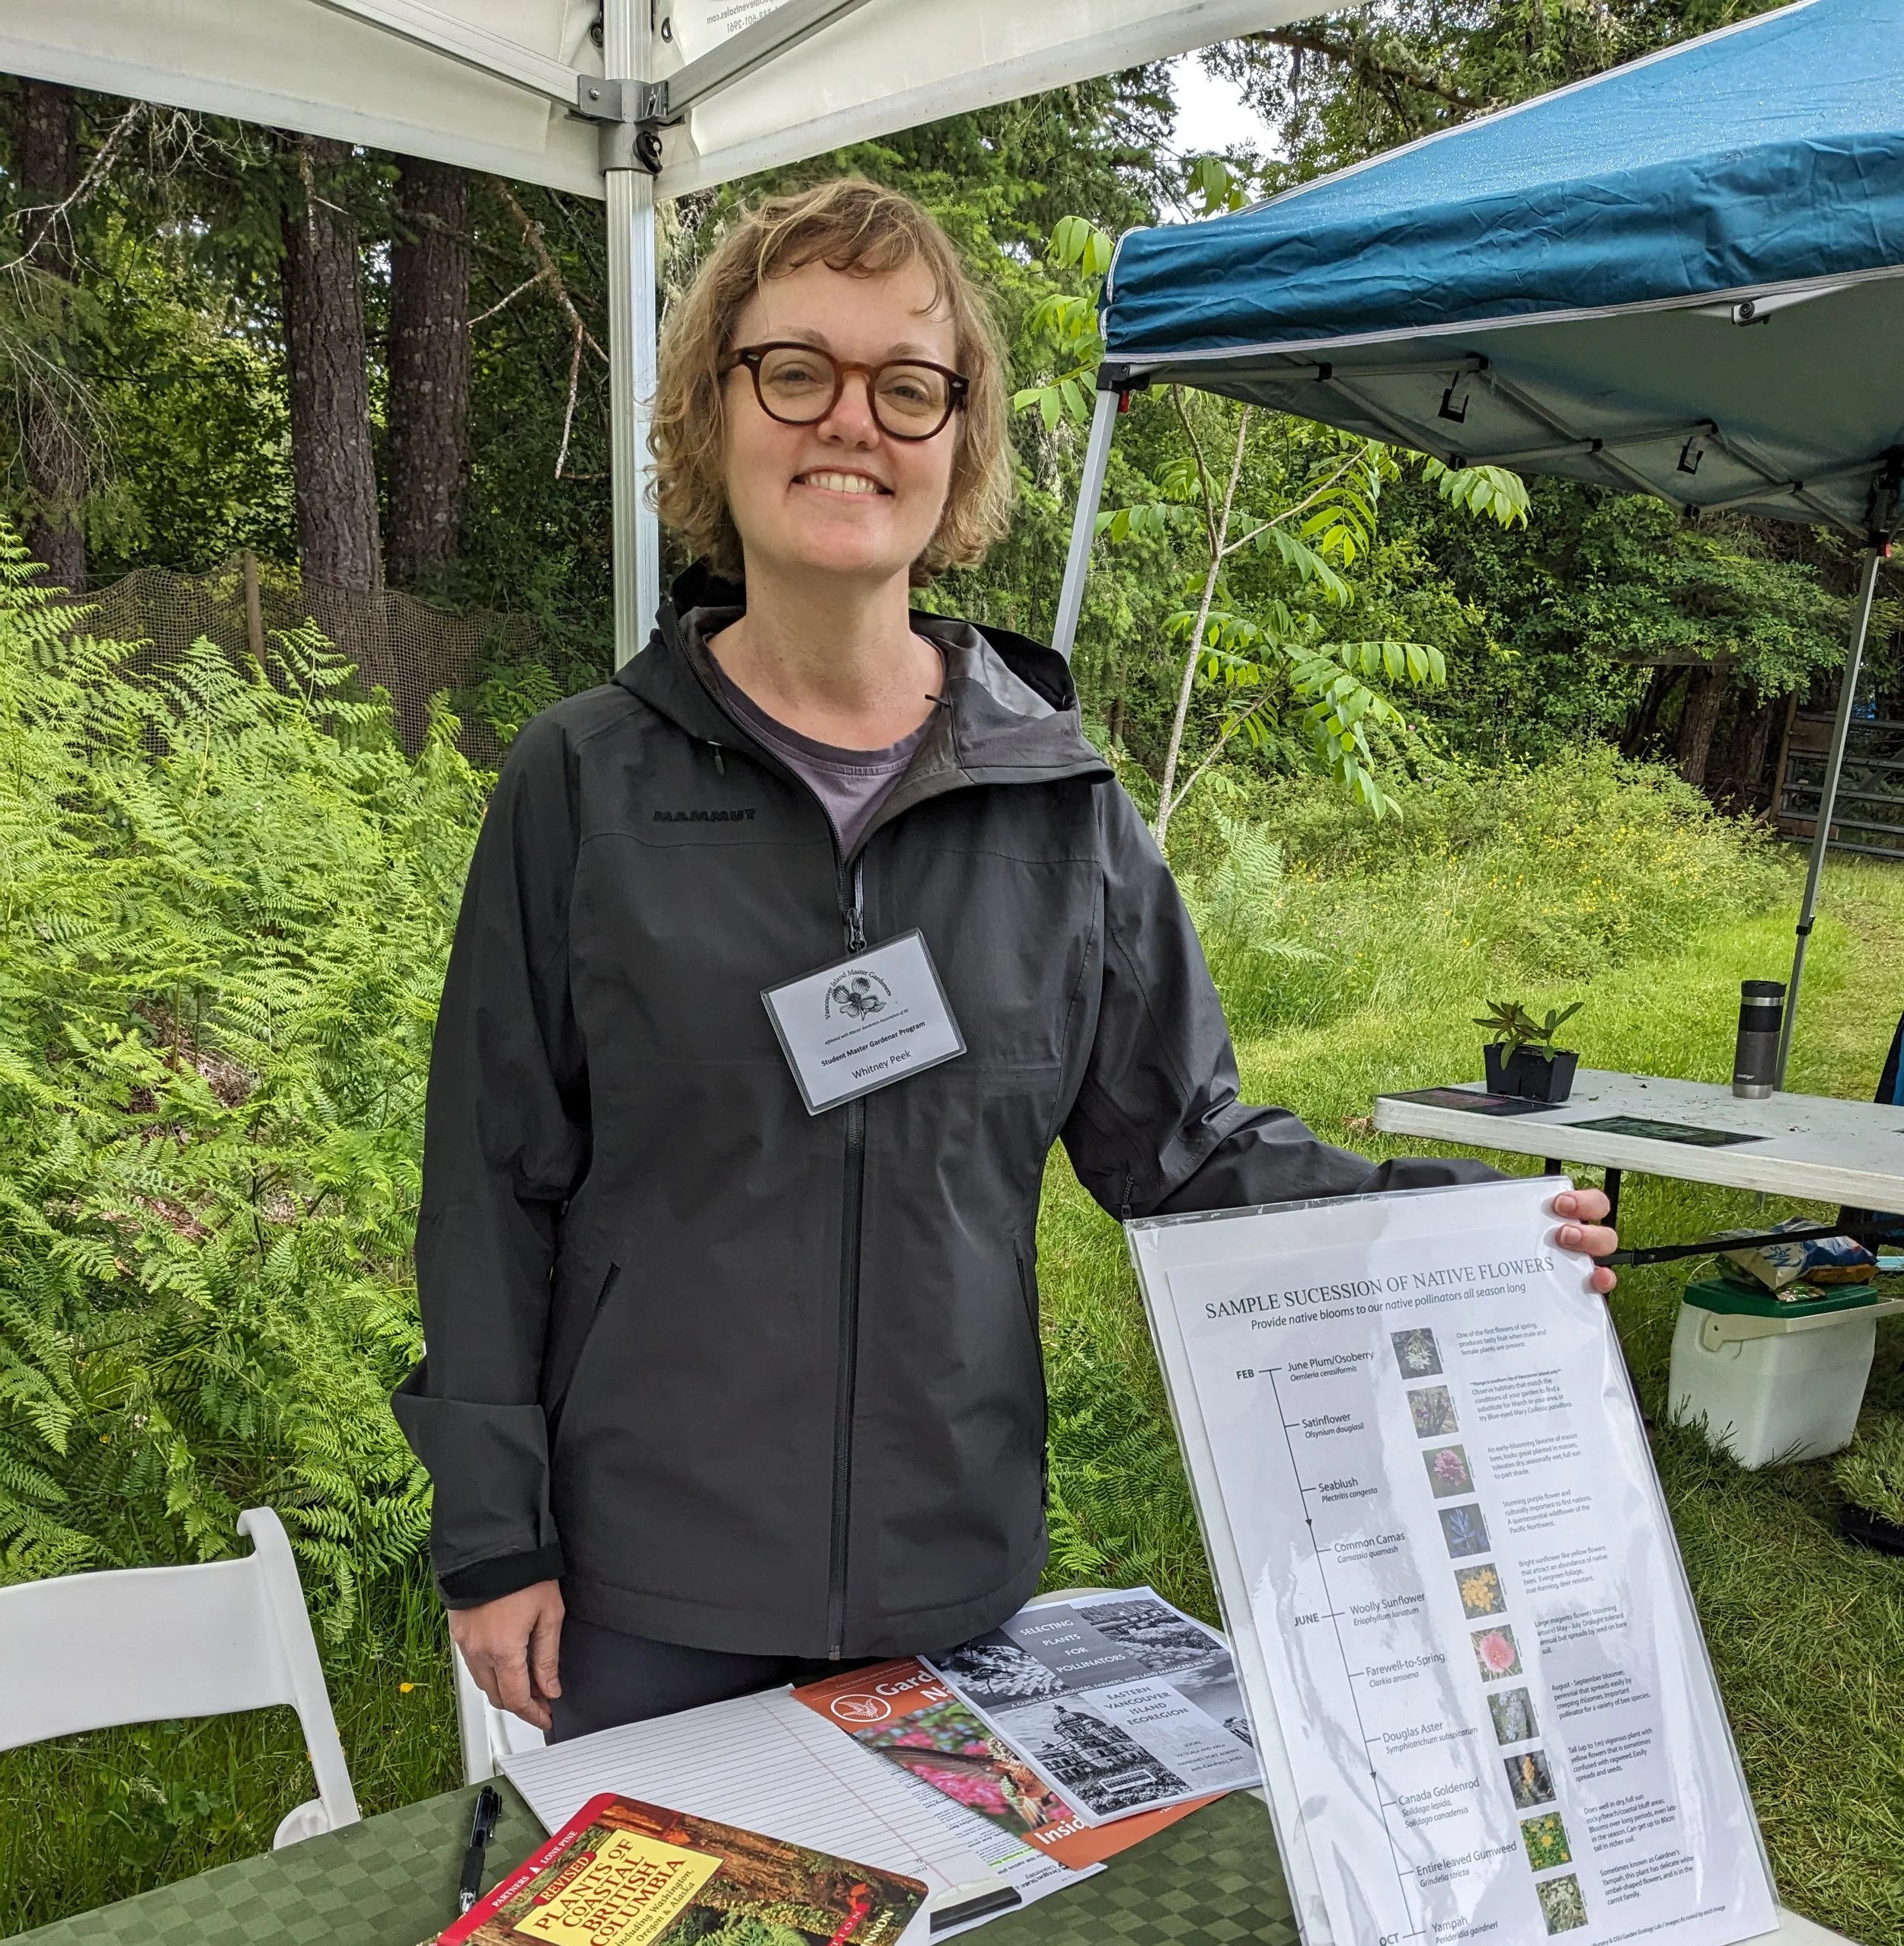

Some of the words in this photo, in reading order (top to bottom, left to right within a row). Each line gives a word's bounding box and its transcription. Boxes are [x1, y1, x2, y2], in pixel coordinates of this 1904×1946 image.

[653, 808, 756, 822] MAMMUT
[825, 986, 833, 1020] Vancouver
[830, 972, 847, 987] Island
[868, 972, 892, 996] Gardeners
[821, 1053, 847, 1066] Student
[845, 1043, 868, 1057] Master
[869, 1031, 898, 1047] Gardener
[898, 1021, 925, 1036] Program
[851, 1059, 888, 1079] Whitney
[889, 1050, 912, 1064] Peek
[1205, 1293, 1281, 1318] SAMPLE
[1283, 1279, 1382, 1307] SUCESSION
[1386, 1275, 1407, 1292] OF
[1411, 1267, 1476, 1289] NATIVE
[1478, 1256, 1554, 1279] FLOWERS
[1251, 1315, 1287, 1331] Provide
[1288, 1312, 1318, 1324] native
[1319, 1307, 1355, 1320] blooms
[1356, 1305, 1366, 1315] to
[1367, 1303, 1383, 1313] our
[1385, 1298, 1413, 1310] native
[1414, 1292, 1462, 1309] pollinators
[1463, 1288, 1474, 1299] all
[1475, 1286, 1505, 1297] season
[1506, 1283, 1525, 1294] long
[1288, 1362, 1308, 1372] June
[1308, 1351, 1374, 1368] Plum/Osoberry
[1235, 1369, 1254, 1380] FEB
[1289, 1370, 1319, 1382] Oemleria
[1319, 1365, 1357, 1377] cerasiformis
[1302, 1414, 1350, 1429] Satinflower
[1305, 1428, 1335, 1439] Olsynium
[1335, 1422, 1364, 1433] douglasii
[1318, 1477, 1359, 1493] Seablush
[1321, 1491, 1349, 1503] Plectritis
[1349, 1487, 1378, 1498] congesta
[1334, 1538, 1375, 1552] Common
[1375, 1532, 1405, 1545] Camas
[1337, 1551, 1368, 1564] Camassia
[1368, 1545, 1398, 1559] quamash
[1349, 1601, 1380, 1615] Woolly
[1381, 1593, 1425, 1609] Sunflower
[1020, 1619, 1074, 1635] SELECTING
[1294, 1612, 1320, 1627] JUNE
[1353, 1612, 1391, 1626] Eriophyllum
[1391, 1607, 1419, 1619] lanatum
[1042, 1633, 1081, 1646] PLANTS
[1064, 1647, 1088, 1656] FOR
[1056, 1654, 1126, 1673] POLLINATORS
[1365, 1653, 1446, 1676] Farewell-to-Spring
[1369, 1676, 1392, 1688] Clarkia
[1392, 1671, 1419, 1683] amoena
[1551, 1682, 1570, 1692] August
[1573, 1675, 1602, 1686] September
[1601, 1670, 1625, 1679] bloomer,
[1554, 1688, 1579, 1702] perennial
[1589, 1682, 1610, 1693] spreads
[1610, 1678, 1624, 1687] easily
[1104, 1692, 1172, 1709] VANCOUVER
[1106, 1686, 1152, 1700] EASTERN
[1556, 1699, 1580, 1710] creeping
[1579, 1694, 1605, 1705] rhizomes.
[1603, 1687, 1630, 1698] Important
[1126, 1707, 1189, 1725] ECOREGION
[1129, 1702, 1167, 1714] ISLAND
[1558, 1708, 1584, 1720] pollinator
[1596, 1701, 1614, 1710] variety
[1630, 1692, 1650, 1702] species.
[1382, 1727, 1420, 1743] Douglas
[1420, 1721, 1442, 1734] Aster
[1567, 1745, 1577, 1754] Tall
[1604, 1734, 1627, 1746] vigorous
[1627, 1730, 1641, 1740] plant
[1640, 1727, 1653, 1736] with
[1570, 1754, 1588, 1764] yellow
[1587, 1749, 1607, 1759] flowers
[1606, 1746, 1618, 1754] that
[1623, 1738, 1651, 1750] sometimes
[1573, 1760, 1597, 1773] confused
[1596, 1758, 1609, 1766] with
[1609, 1751, 1634, 1764] ragweed.
[1632, 1748, 1647, 1758] Easily
[1575, 1771, 1596, 1782] spreads
[1596, 1767, 1607, 1777] and
[1606, 1764, 1623, 1774] seeds.
[1398, 1789, 1432, 1806] Canada
[1433, 1775, 1480, 1797] Goldenrod
[1401, 1804, 1430, 1817] Solidago
[1430, 1798, 1452, 1810] lepida,
[1404, 1816, 1433, 1829] Solidago
[1433, 1806, 1469, 1821] canadensis
[1473, 1839, 1517, 1861] Gumweed
[492, 1875, 529, 1906] PARTNERS
[540, 1846, 562, 1864] LONE
[559, 1831, 577, 1848] PINE
[540, 1857, 589, 1900] REVISED
[1420, 1874, 1449, 1887] Grindelia
[1449, 1869, 1469, 1880] stricta
[534, 1863, 612, 1932] PLANTS
[609, 1839, 634, 1861] OF
[562, 1855, 644, 1928] COASTAL
[580, 1861, 660, 1933] BRITISH
[590, 1860, 687, 1946] COLUMBIA
[636, 1916, 665, 1941] Oregon
[672, 1882, 695, 1908] Alaska
[615, 1914, 653, 1946] including
[1431, 1915, 1468, 1933] Yampah
[1378, 1932, 1398, 1946] OCT
